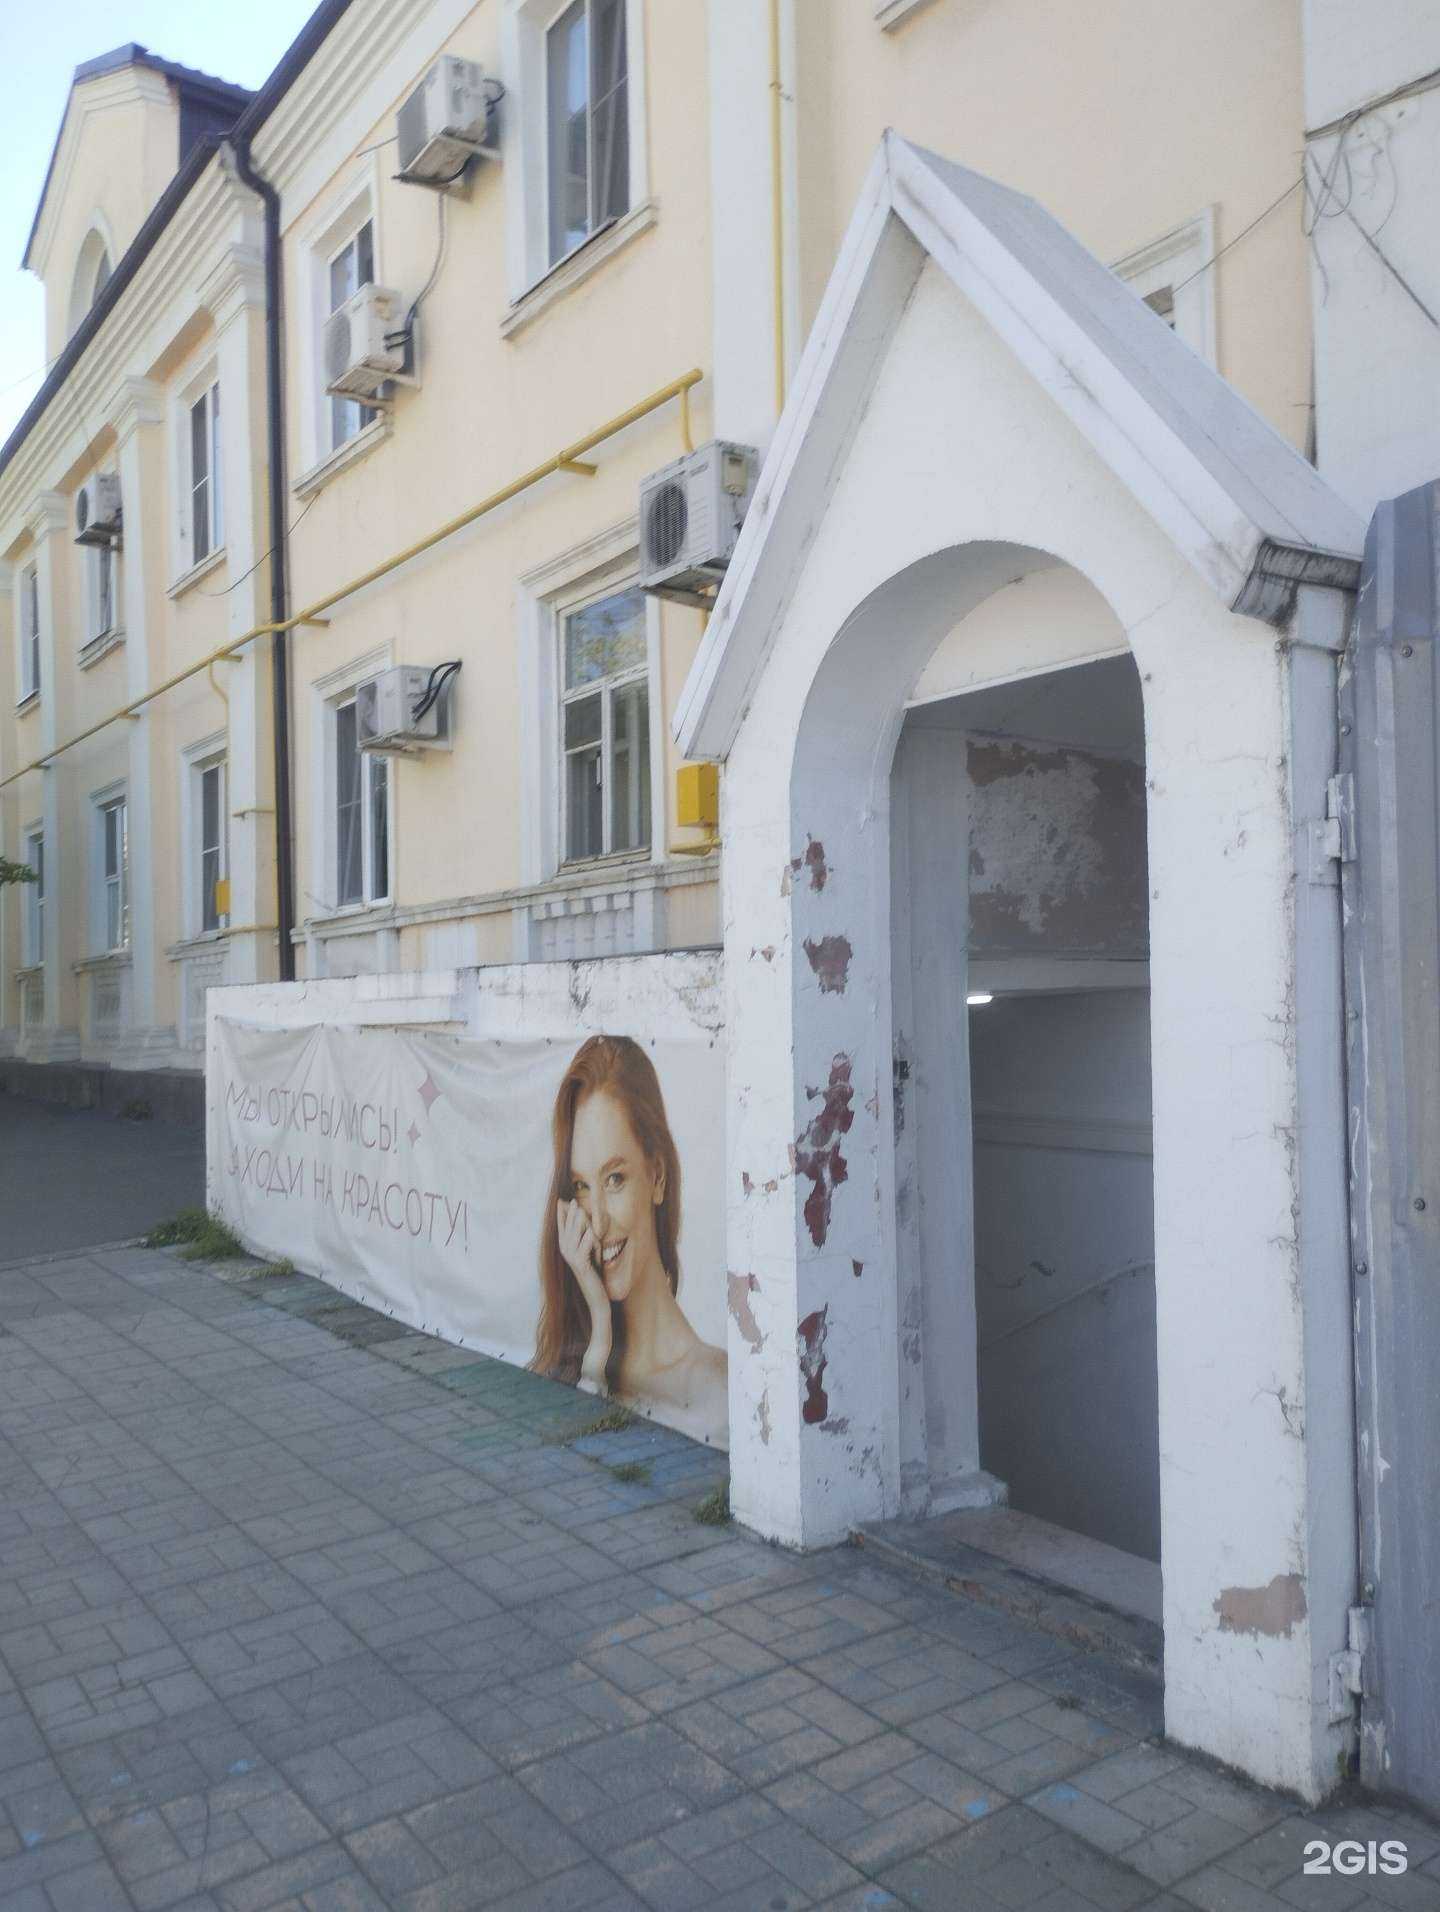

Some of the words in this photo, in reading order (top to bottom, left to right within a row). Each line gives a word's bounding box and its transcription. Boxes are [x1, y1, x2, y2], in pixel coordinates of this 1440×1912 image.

[225, 1081, 261, 1121] МЫ
[269, 1087, 398, 1154] ОТКРЫЛИСЬ!
[313, 1160, 334, 1207] НА
[341, 1169, 468, 1254] КРАСОТУ!
